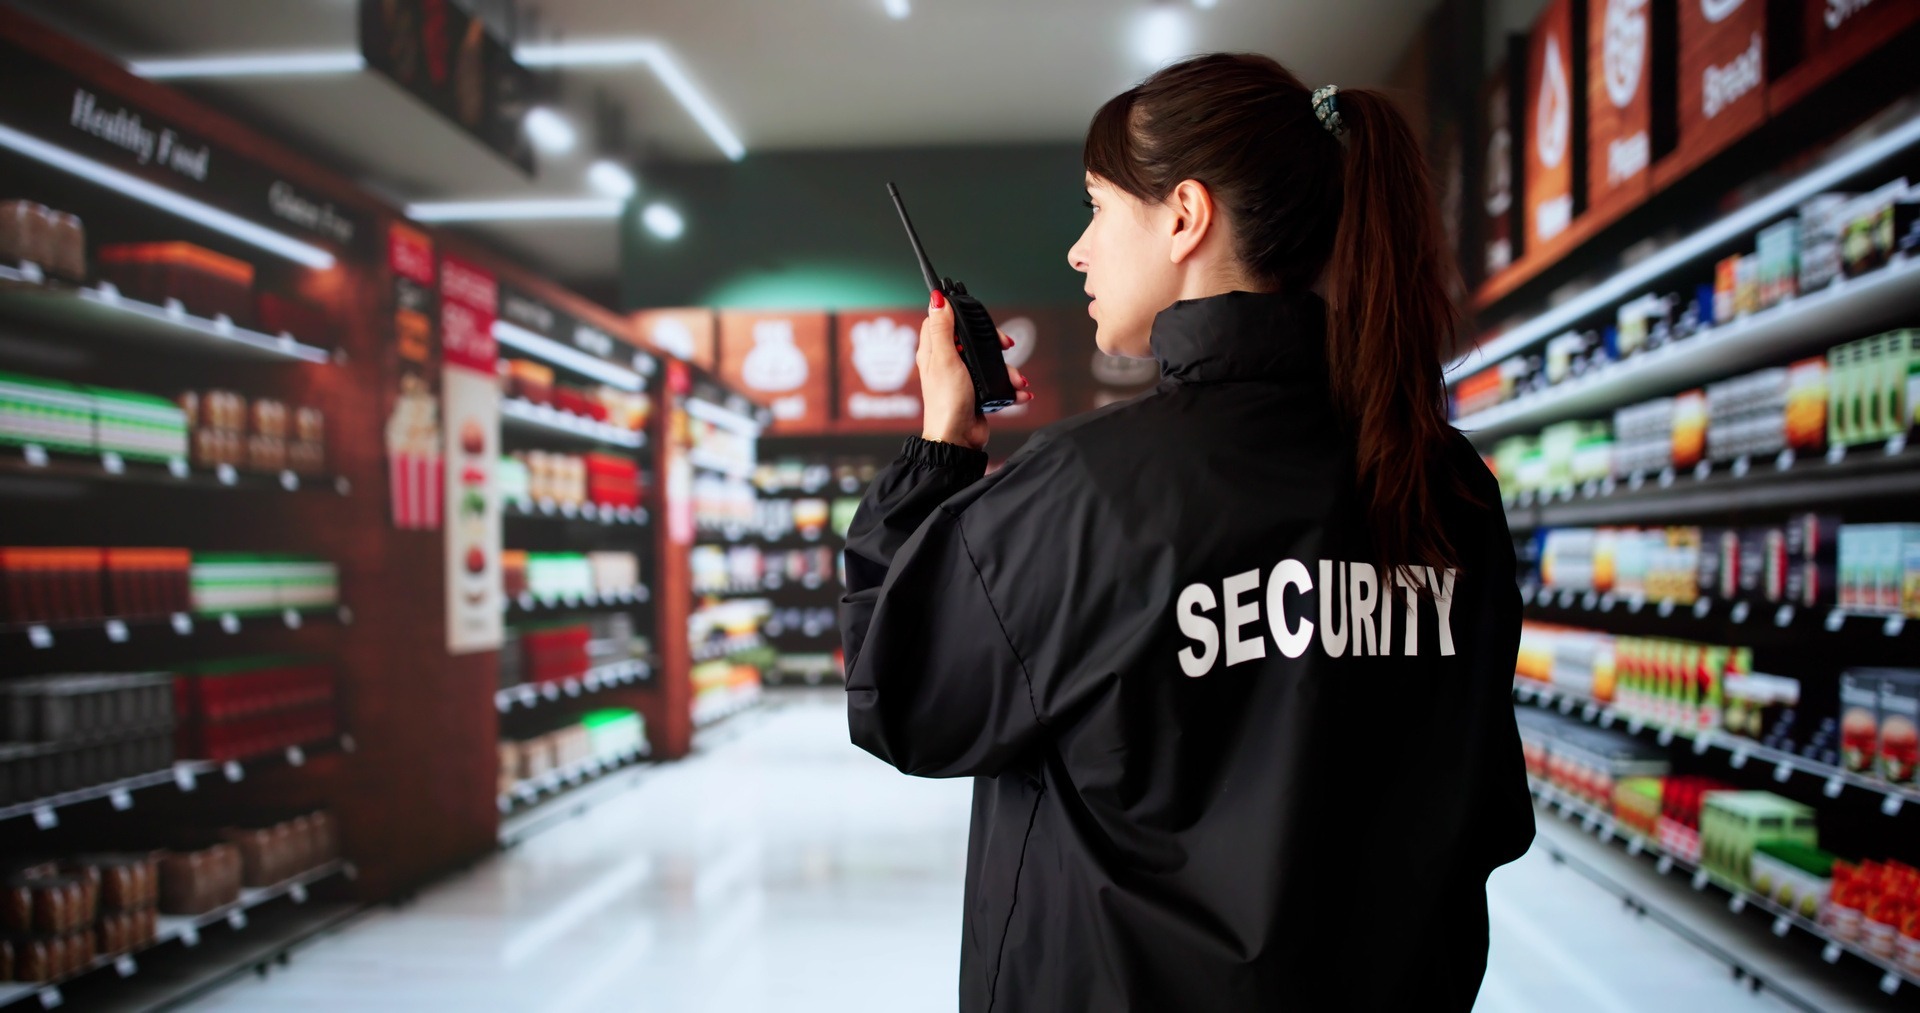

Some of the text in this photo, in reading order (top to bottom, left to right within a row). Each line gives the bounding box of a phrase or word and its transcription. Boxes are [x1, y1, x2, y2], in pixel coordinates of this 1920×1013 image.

[1703, 32, 1762, 119] Bread
[71, 88, 210, 182] Healthy Food
[1176, 558, 1457, 678] SECURITY
